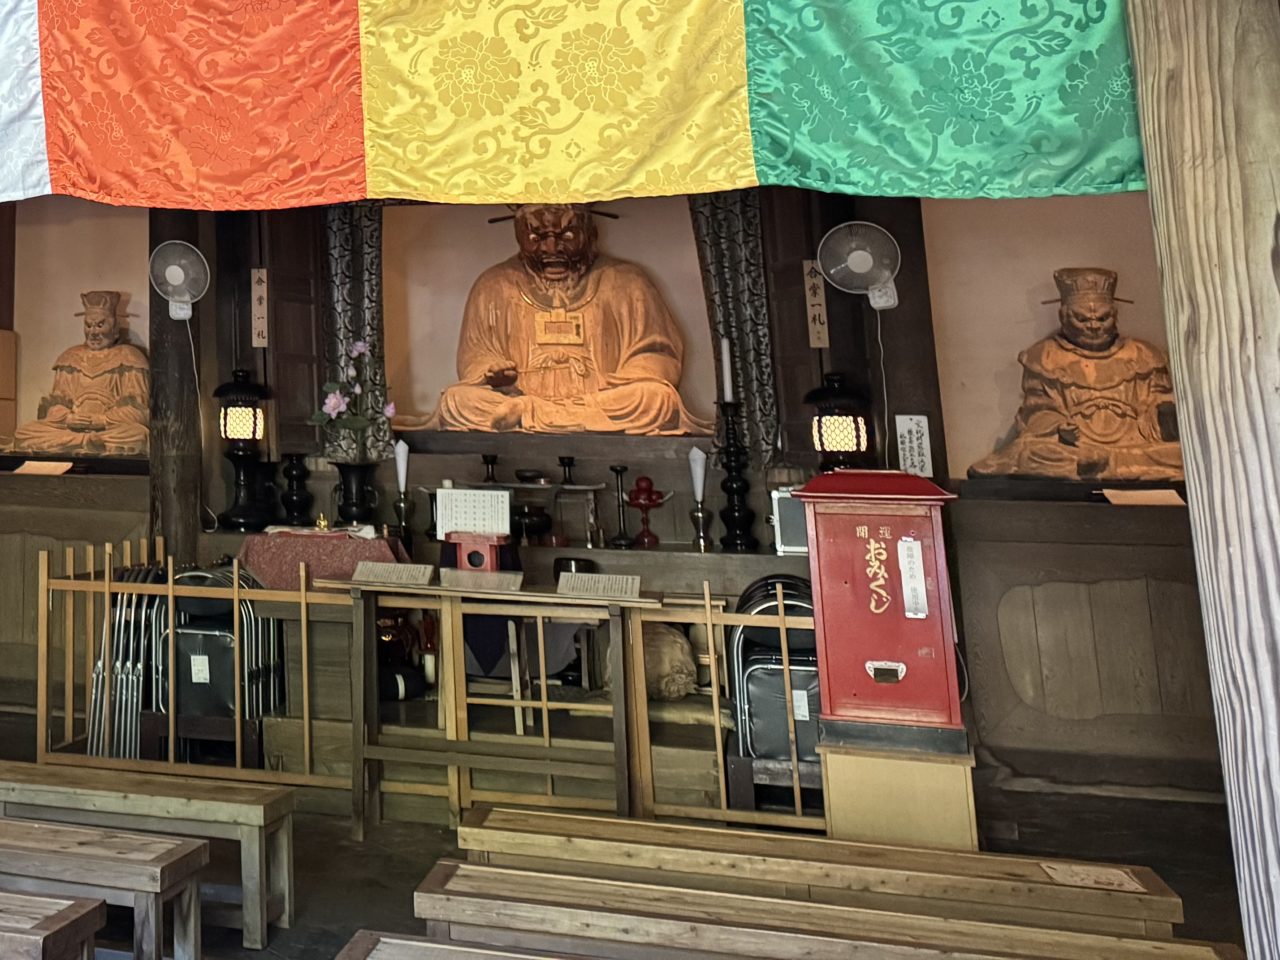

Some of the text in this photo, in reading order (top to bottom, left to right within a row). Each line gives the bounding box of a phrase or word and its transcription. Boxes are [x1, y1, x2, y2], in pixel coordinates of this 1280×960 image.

[255, 277, 266, 339] 合掌一礼
[807, 266, 825, 326] 合掌一礼
[865, 538, 892, 614] おみくじ
